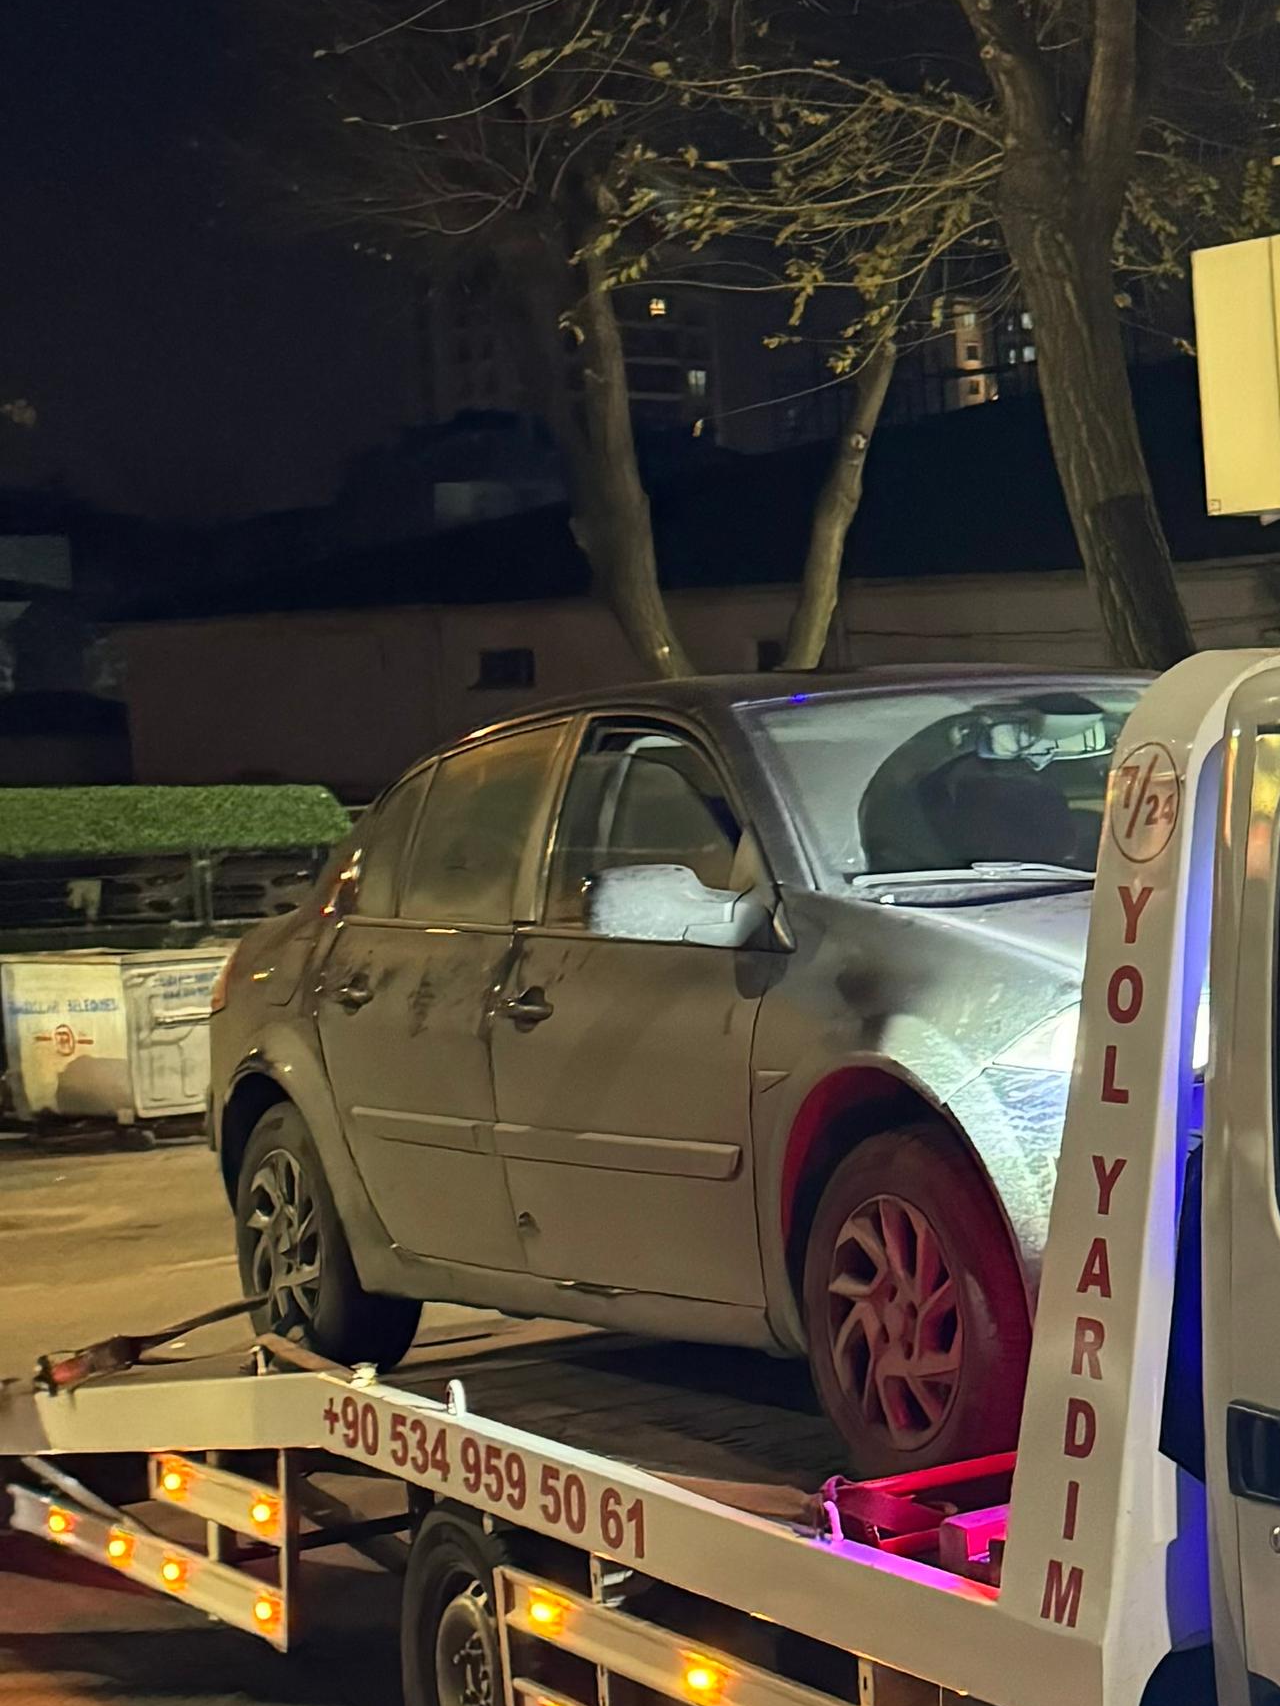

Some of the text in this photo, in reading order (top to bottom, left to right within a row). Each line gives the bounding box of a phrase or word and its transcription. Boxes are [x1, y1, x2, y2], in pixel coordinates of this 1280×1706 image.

[1122, 754, 1174, 838] 7/24
[1040, 886, 1153, 1628] YOL YARDIM
[323, 1395, 645, 1559] +90 534 959 50 61
